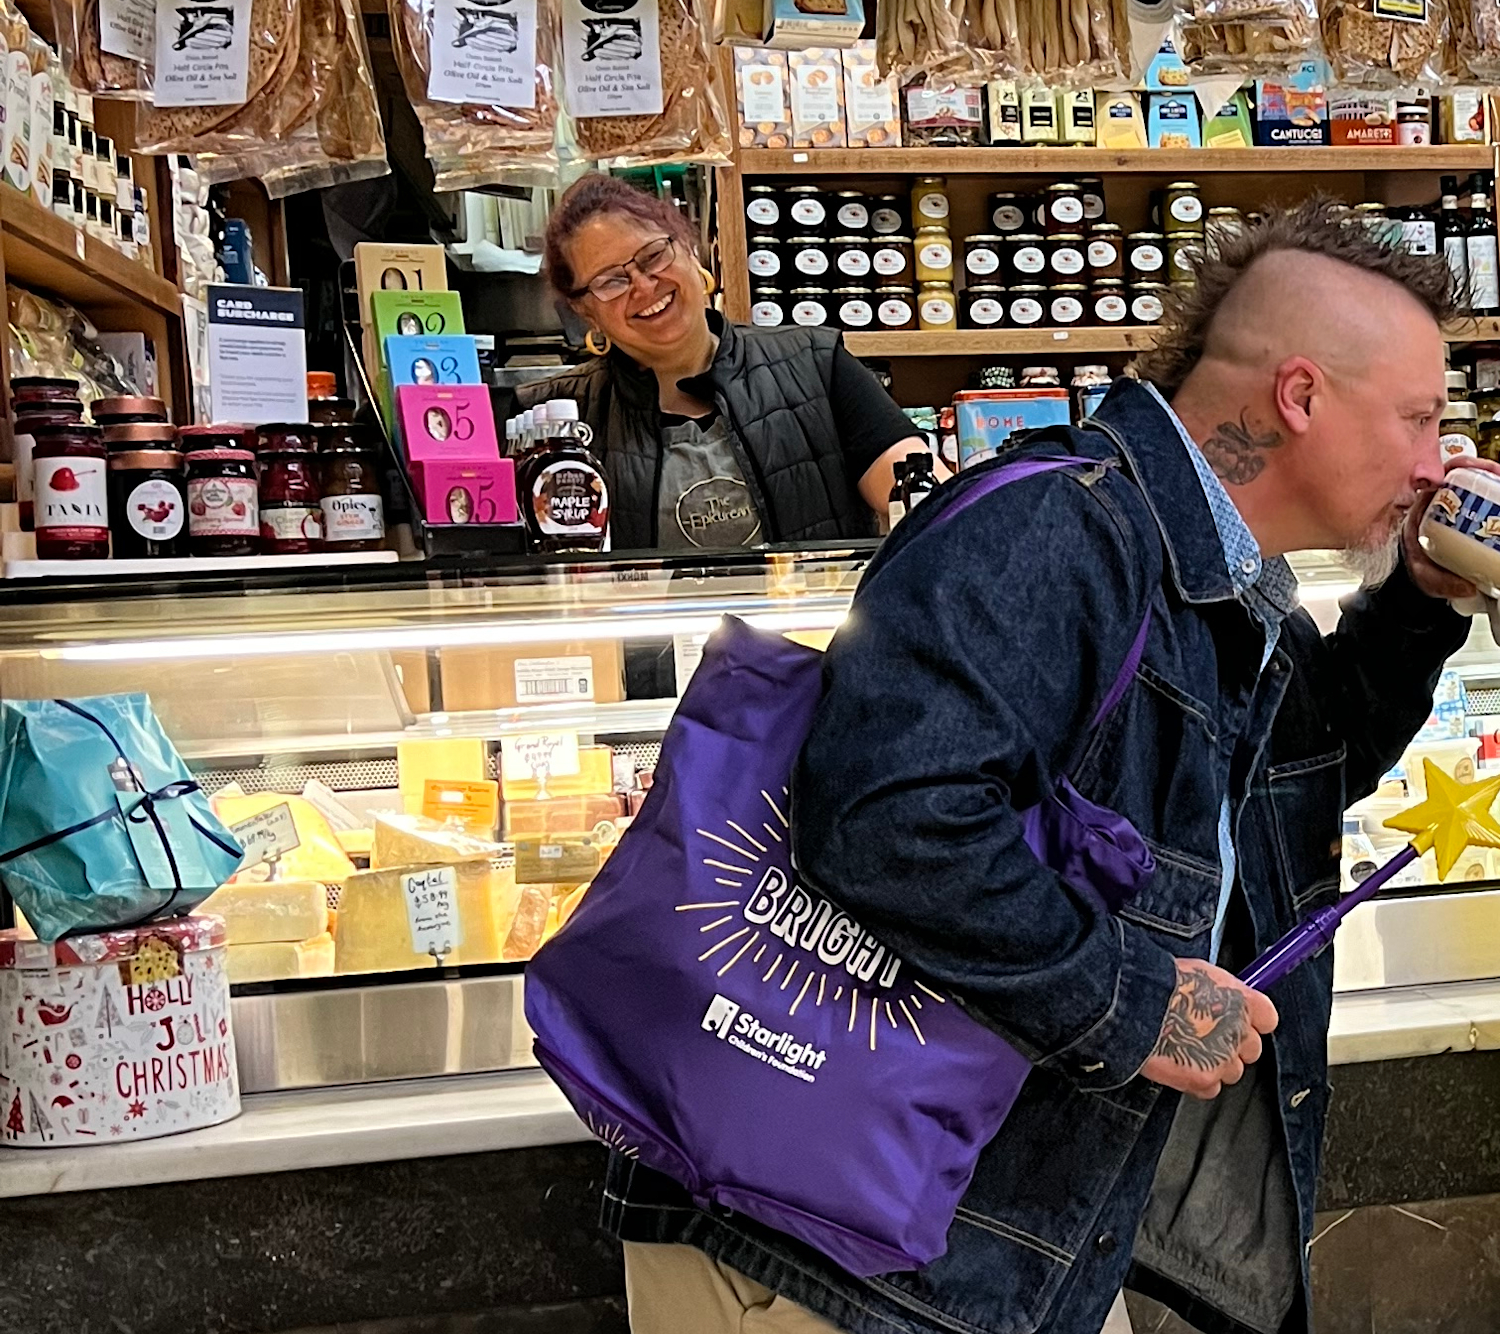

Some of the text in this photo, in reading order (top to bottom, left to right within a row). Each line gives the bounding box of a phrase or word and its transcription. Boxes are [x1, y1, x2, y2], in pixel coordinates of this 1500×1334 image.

[216, 299, 252, 309] CARD
[216, 309, 295, 322] SURCHARGE
[423, 402, 475, 442] 05
[446, 481, 496, 523] 05
[550, 496, 591, 508] MAPLE
[552, 508, 590, 521] SYRUP
[704, 496, 730, 514] The
[689, 506, 752, 531] Epicurean
[126, 973, 194, 1016] HOLLY
[734, 1013, 826, 1069] Starlight
[115, 1043, 230, 1099] CHRISTMAS
[728, 1033, 816, 1083] Children's Foundation
